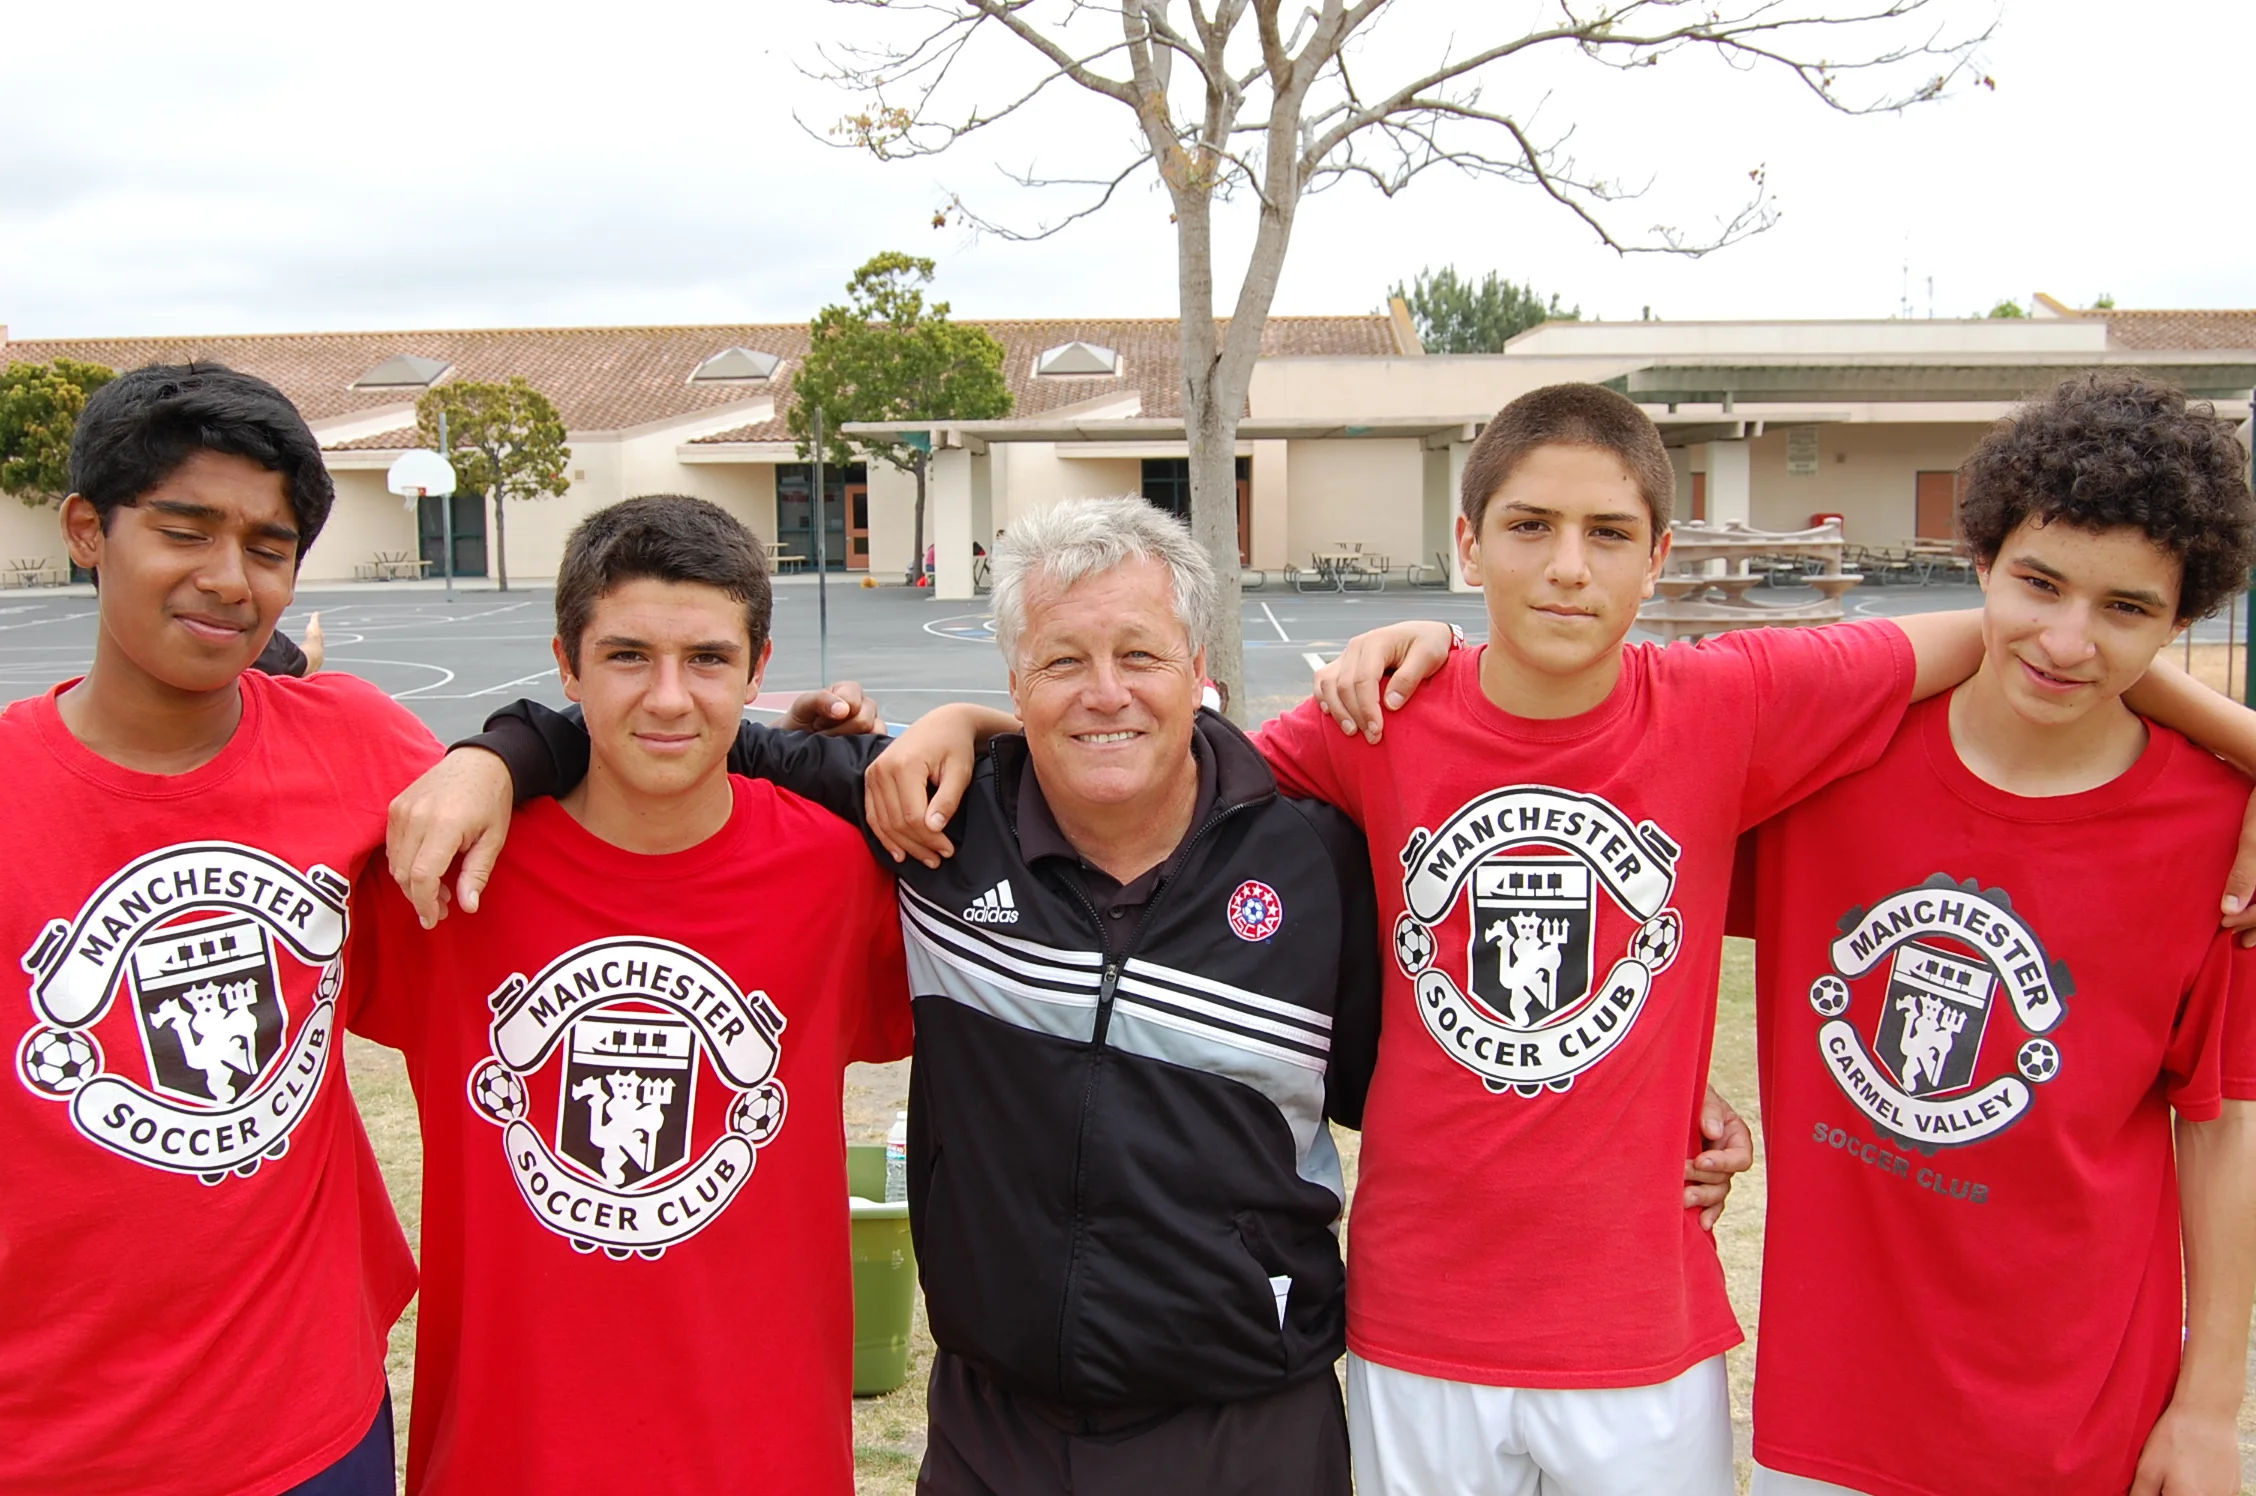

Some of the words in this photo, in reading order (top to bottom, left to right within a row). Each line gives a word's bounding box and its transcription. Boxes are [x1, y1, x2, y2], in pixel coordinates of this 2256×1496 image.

[1427, 807, 1642, 883] MANCHESTER
[79, 867, 314, 967] MANCHESTER
[963, 905, 1019, 923] adidas
[1231, 905, 1279, 937] NSCAA
[1849, 900, 2049, 1010] MANCHESTER
[527, 960, 745, 1046] MANCHESTER
[1426, 985, 1542, 1067] SOCCER
[1559, 984, 1635, 1057] CLUB
[103, 1102, 259, 1155] SOCCER
[272, 1027, 325, 1117] CLUB
[1829, 1036, 1904, 1127] CARMEL
[1915, 1087, 2012, 1134] VALLEY
[517, 1150, 639, 1231] SOCCER
[657, 1158, 736, 1226] CLUB
[1811, 1121, 1910, 1180] SOCCER
[1917, 1168, 1990, 1205] CLUB
